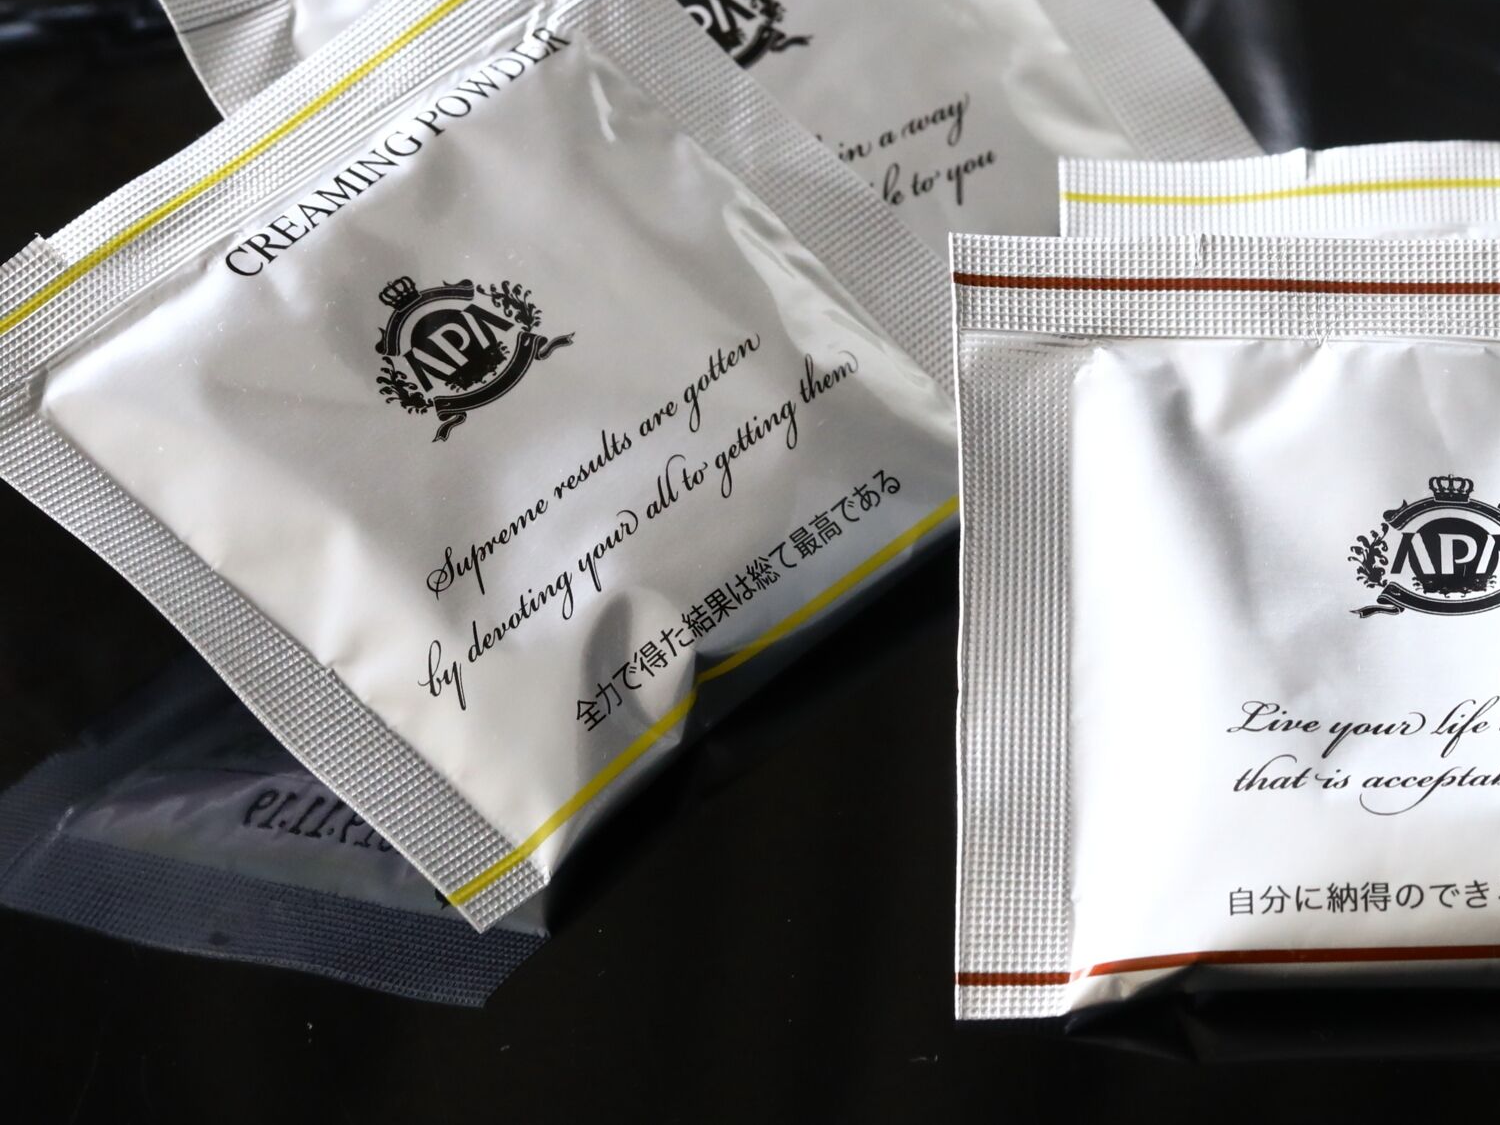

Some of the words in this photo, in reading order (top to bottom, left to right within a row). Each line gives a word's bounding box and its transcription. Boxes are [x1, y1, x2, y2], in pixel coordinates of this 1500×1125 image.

[225, 131, 423, 276] CREAMING
[414, 27, 571, 136] POWDER
[879, 129, 897, 147] a
[901, 92, 970, 146] way
[911, 171, 941, 196] to
[946, 149, 996, 206] you
[418, 640, 467, 710] by
[467, 571, 573, 663] devoting
[578, 510, 639, 592] your
[646, 454, 686, 519] all
[683, 461, 708, 492] to
[715, 399, 798, 499] getting
[799, 350, 858, 403] them
[426, 499, 549, 599] Supreme
[553, 430, 633, 500] results
[639, 401, 678, 437] are
[684, 333, 761, 432] gotten
[576, 469, 901, 731] 全力で得た結果は総て最高である
[1227, 701, 1320, 734] Live
[1322, 712, 1426, 758] your
[1430, 696, 1500, 758] life
[1232, 754, 1310, 793] that
[1315, 768, 1350, 789] is
